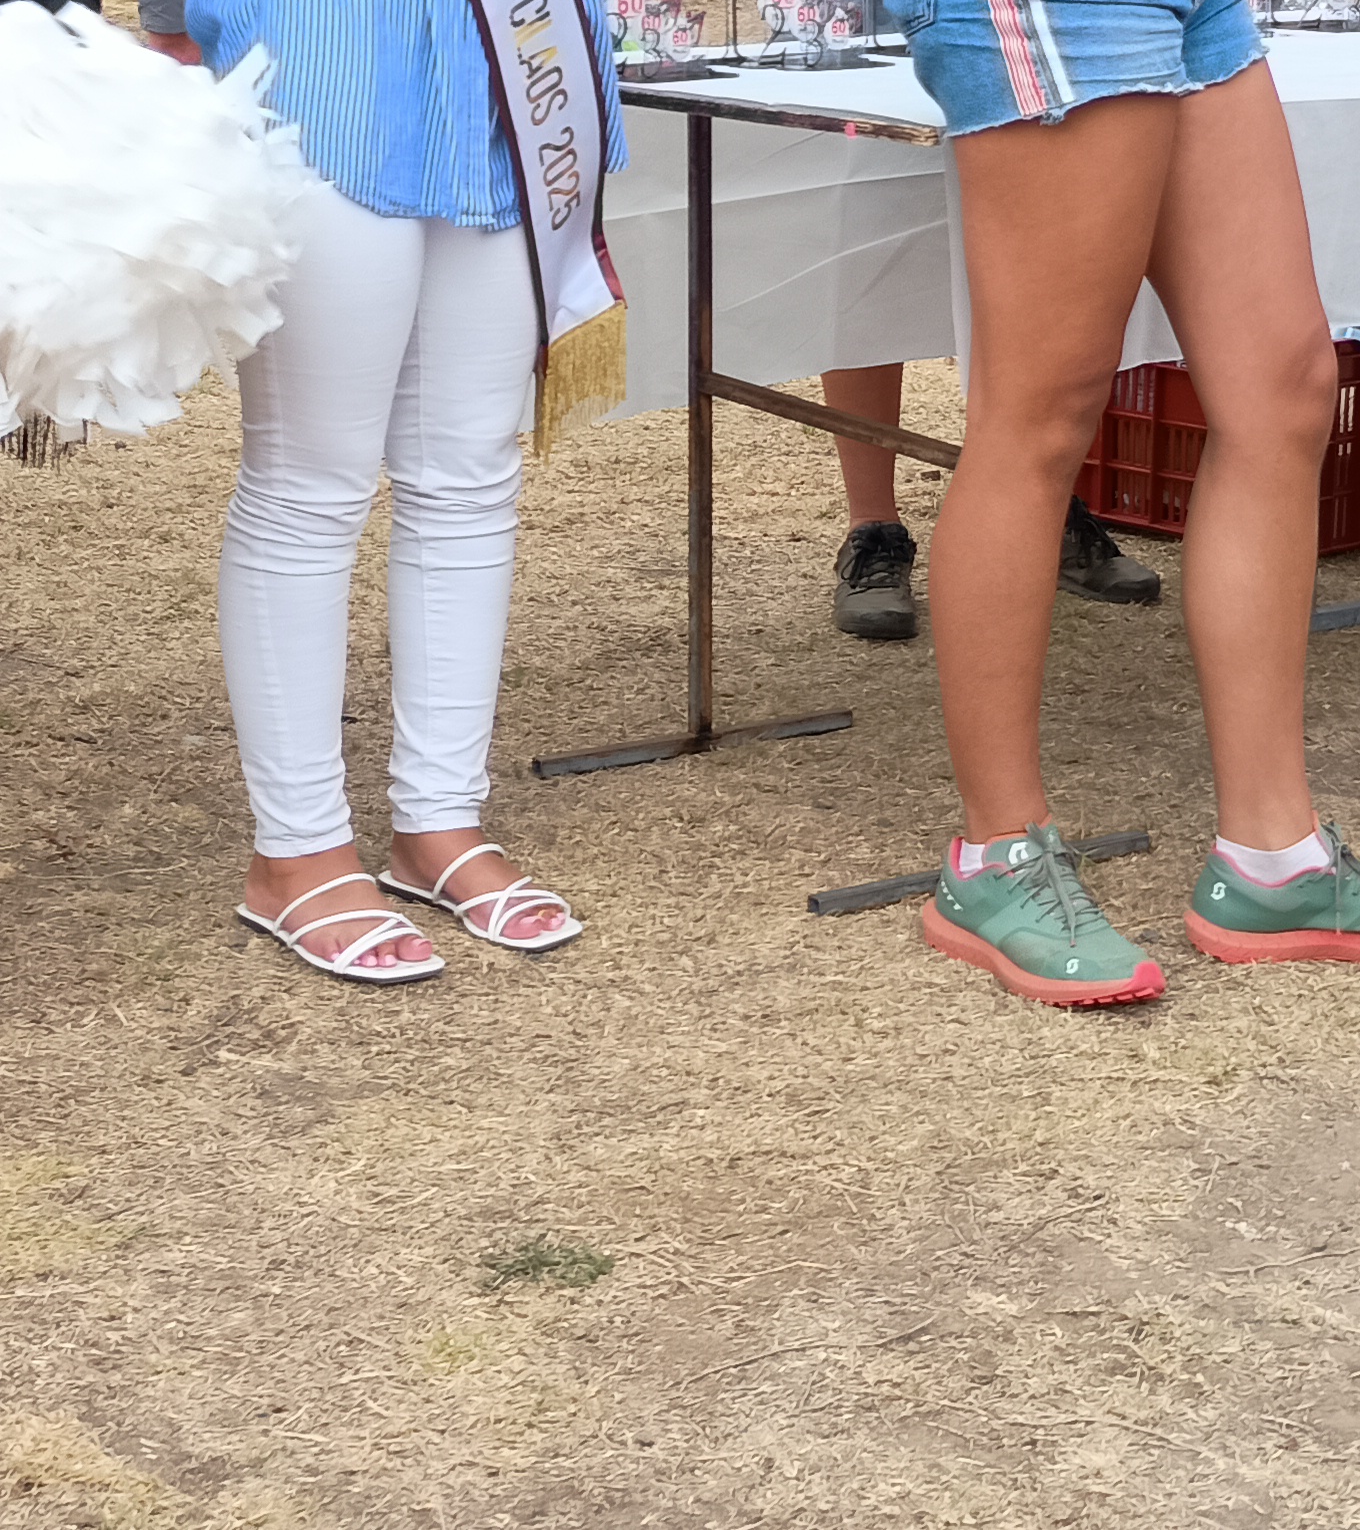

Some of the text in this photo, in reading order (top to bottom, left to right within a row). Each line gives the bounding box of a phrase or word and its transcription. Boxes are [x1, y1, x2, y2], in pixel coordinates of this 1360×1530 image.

[797, 6, 816, 23] 60
[831, 20, 847, 34] 60
[537, 125, 581, 232] 2025
